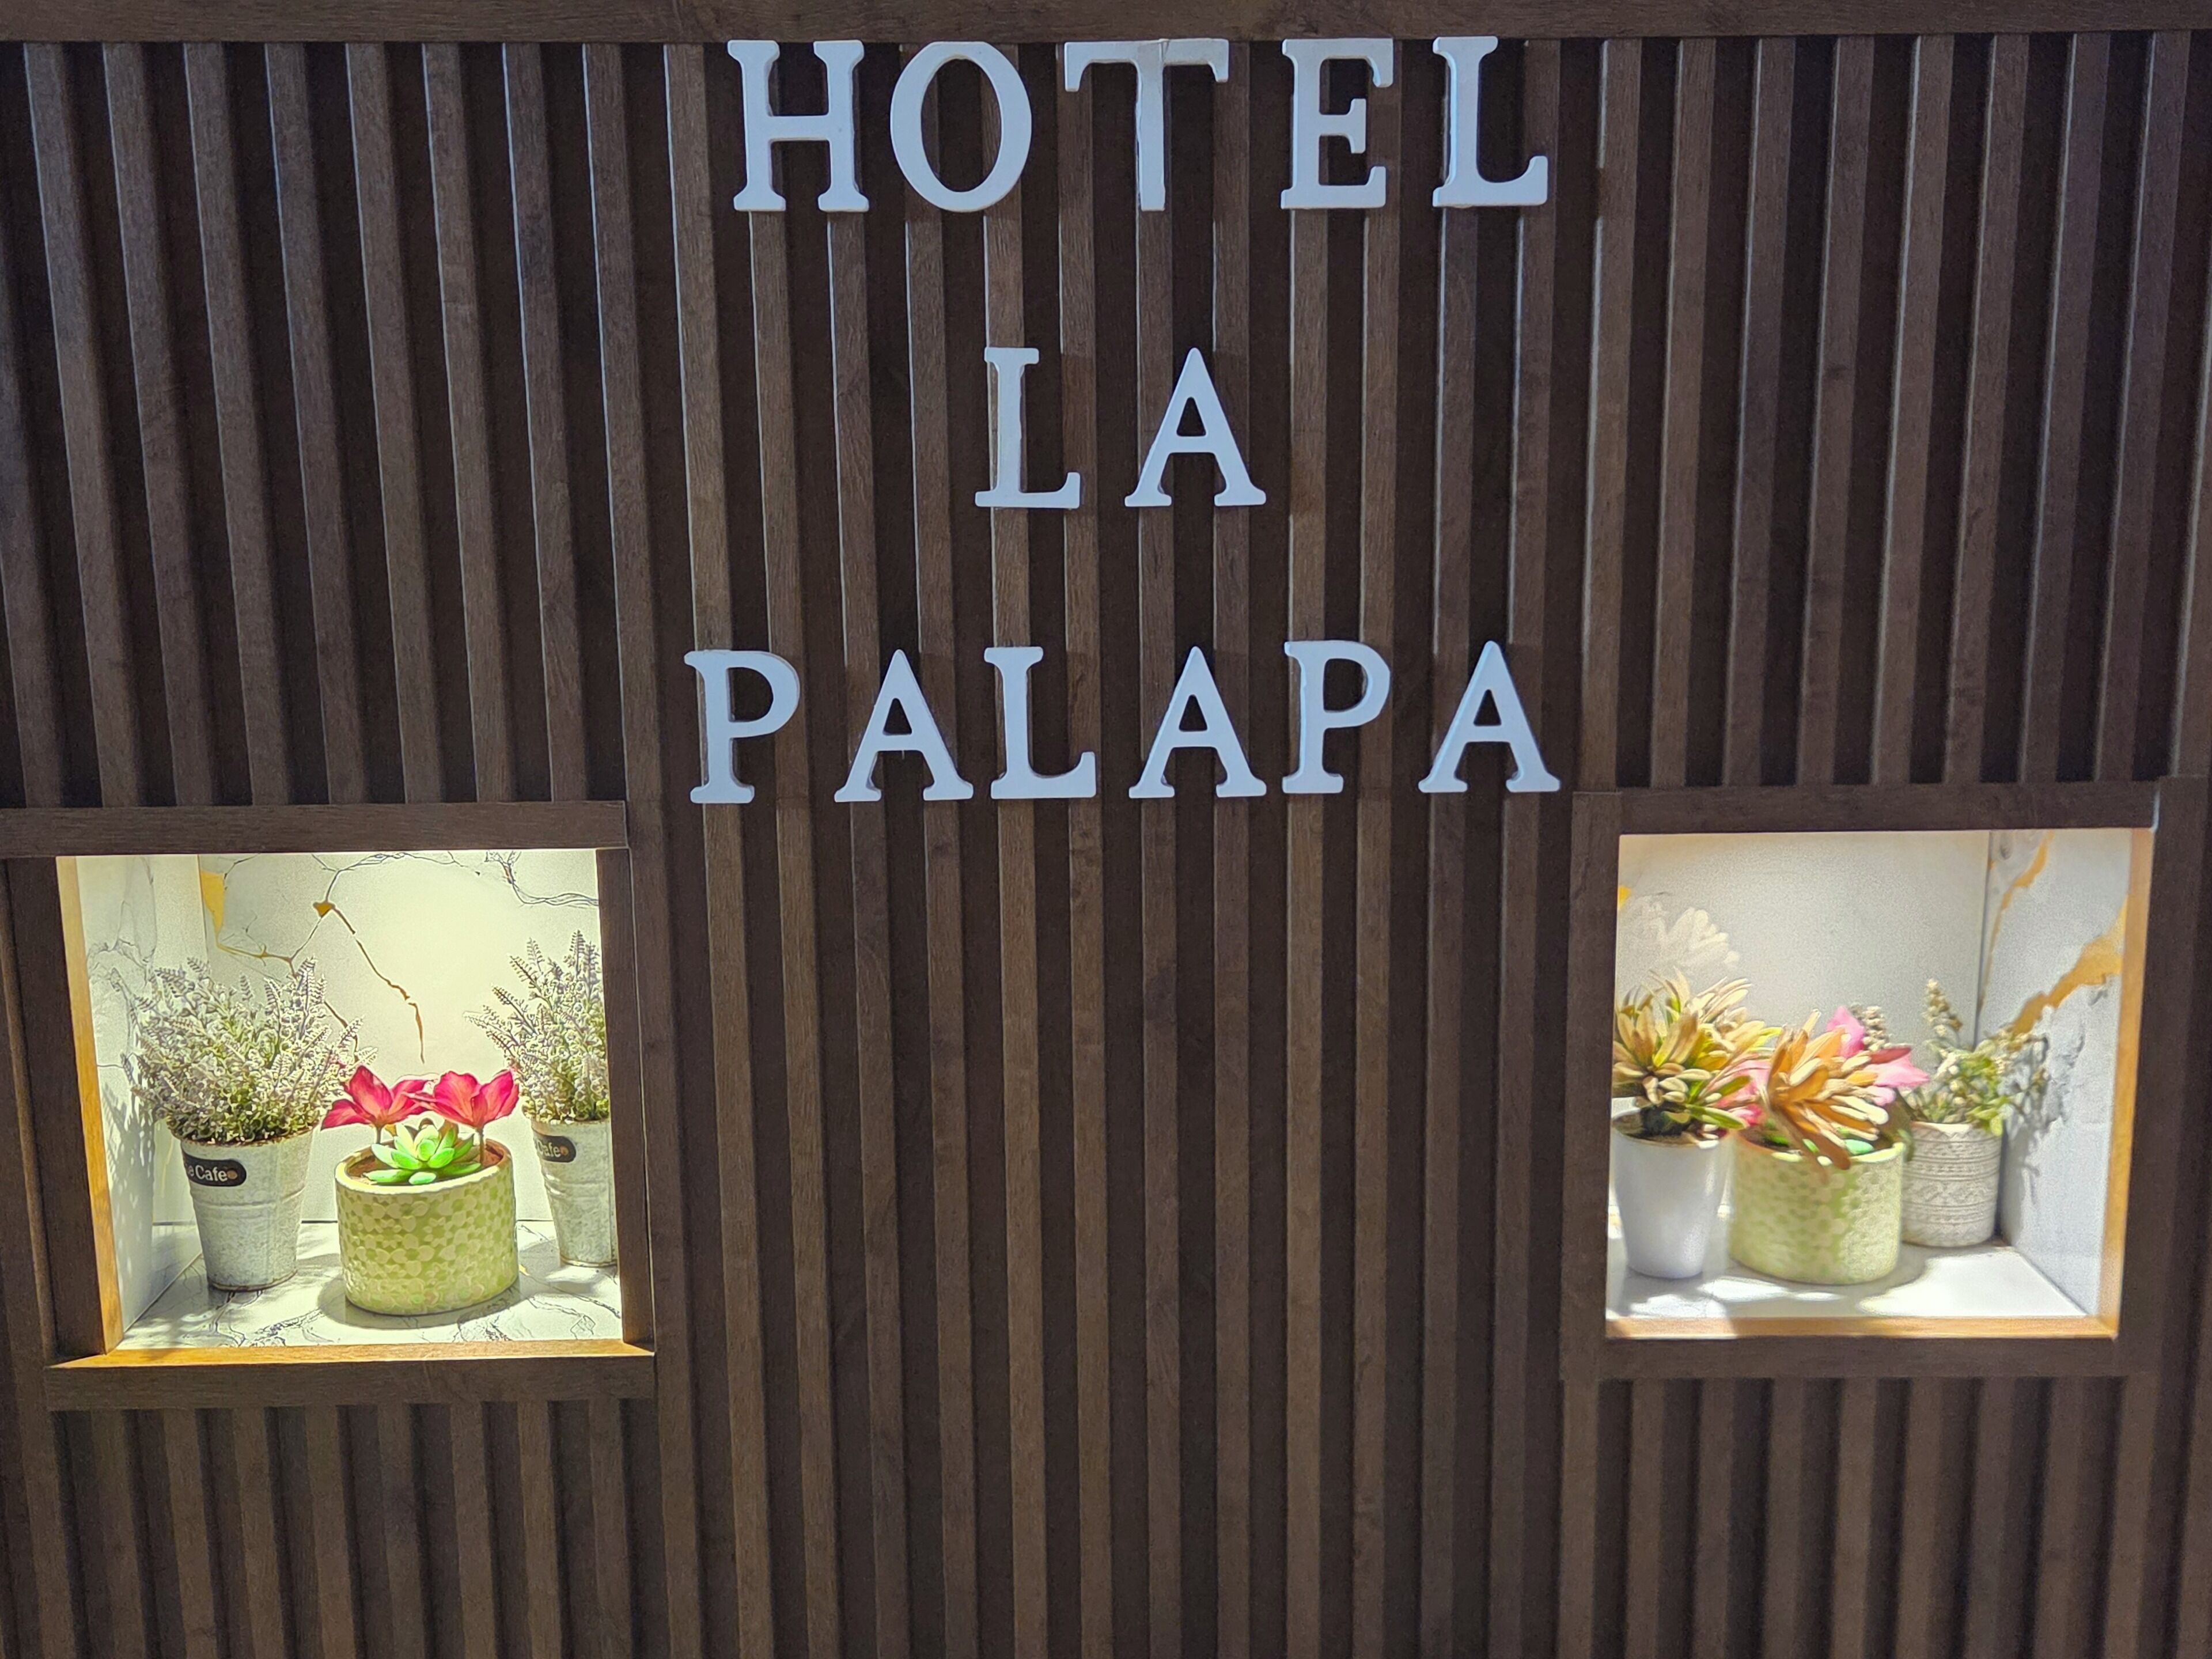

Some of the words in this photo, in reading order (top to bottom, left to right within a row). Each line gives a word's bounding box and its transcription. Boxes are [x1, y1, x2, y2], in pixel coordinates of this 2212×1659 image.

[727, 36, 1550, 213] HOTEL
[975, 347, 1267, 509] LA
[684, 640, 1561, 804] PALAPA
[195, 1164, 228, 1182] Cafe
